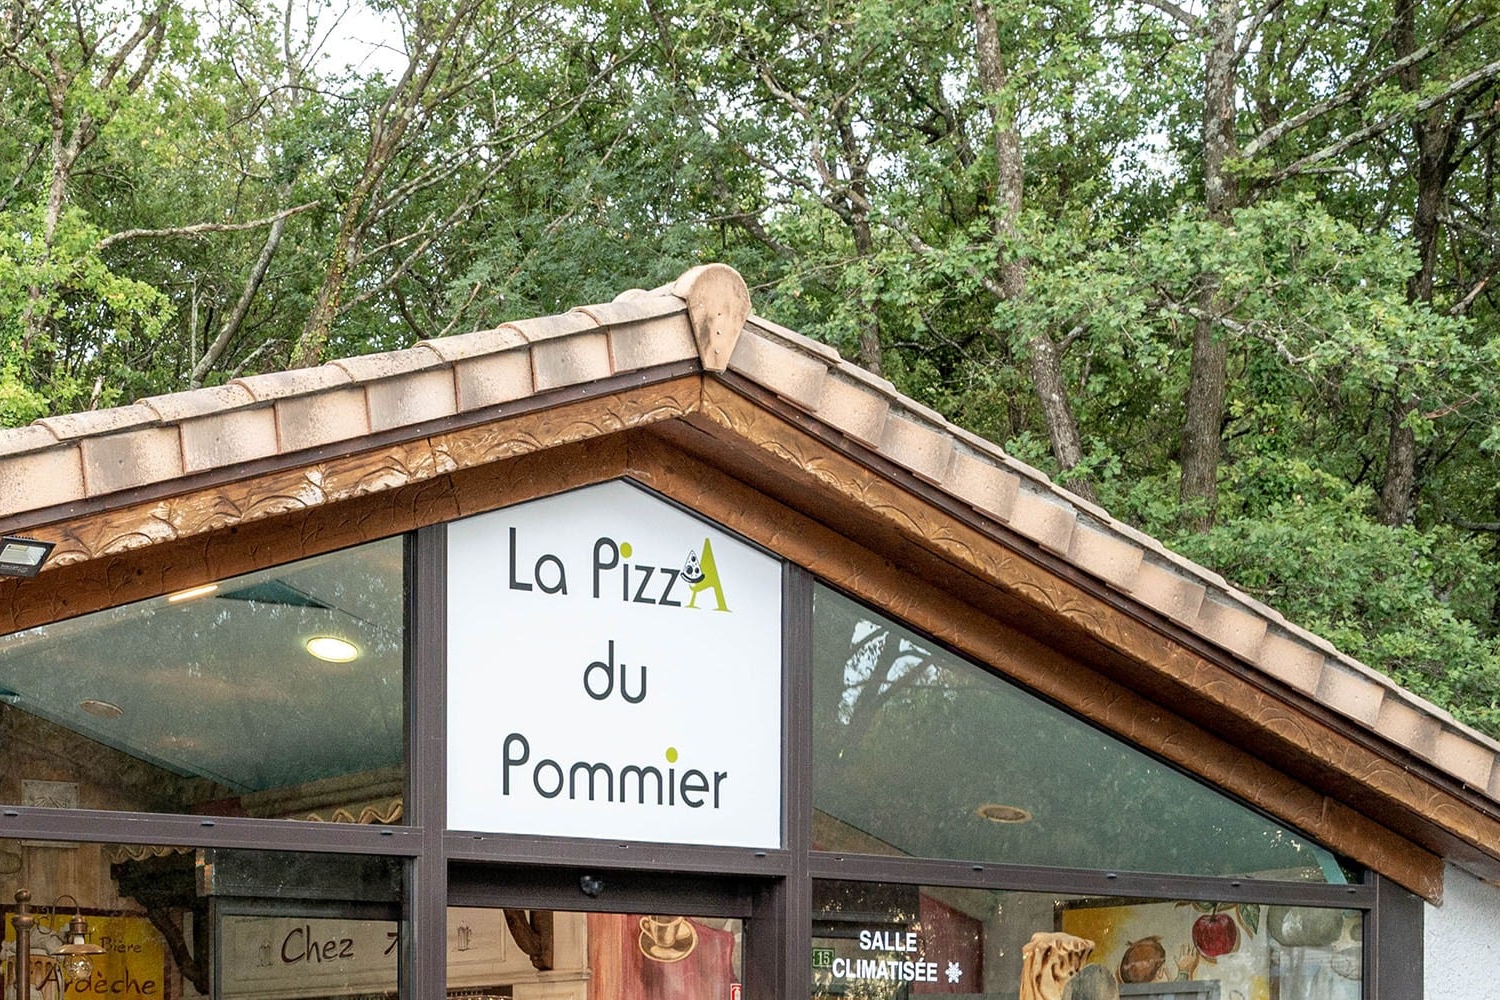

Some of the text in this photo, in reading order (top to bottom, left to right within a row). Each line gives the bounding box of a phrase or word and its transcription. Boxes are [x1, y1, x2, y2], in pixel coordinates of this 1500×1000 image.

[508, 527, 568, 596] La
[583, 639, 647, 704] du
[502, 732, 728, 809] Pommier
[100, 935, 142, 953] Bière
[281, 925, 354, 963] Chez
[859, 930, 918, 952] SALLE
[817, 951, 830, 965] 15
[832, 957, 938, 982] CLIMATISÉE
